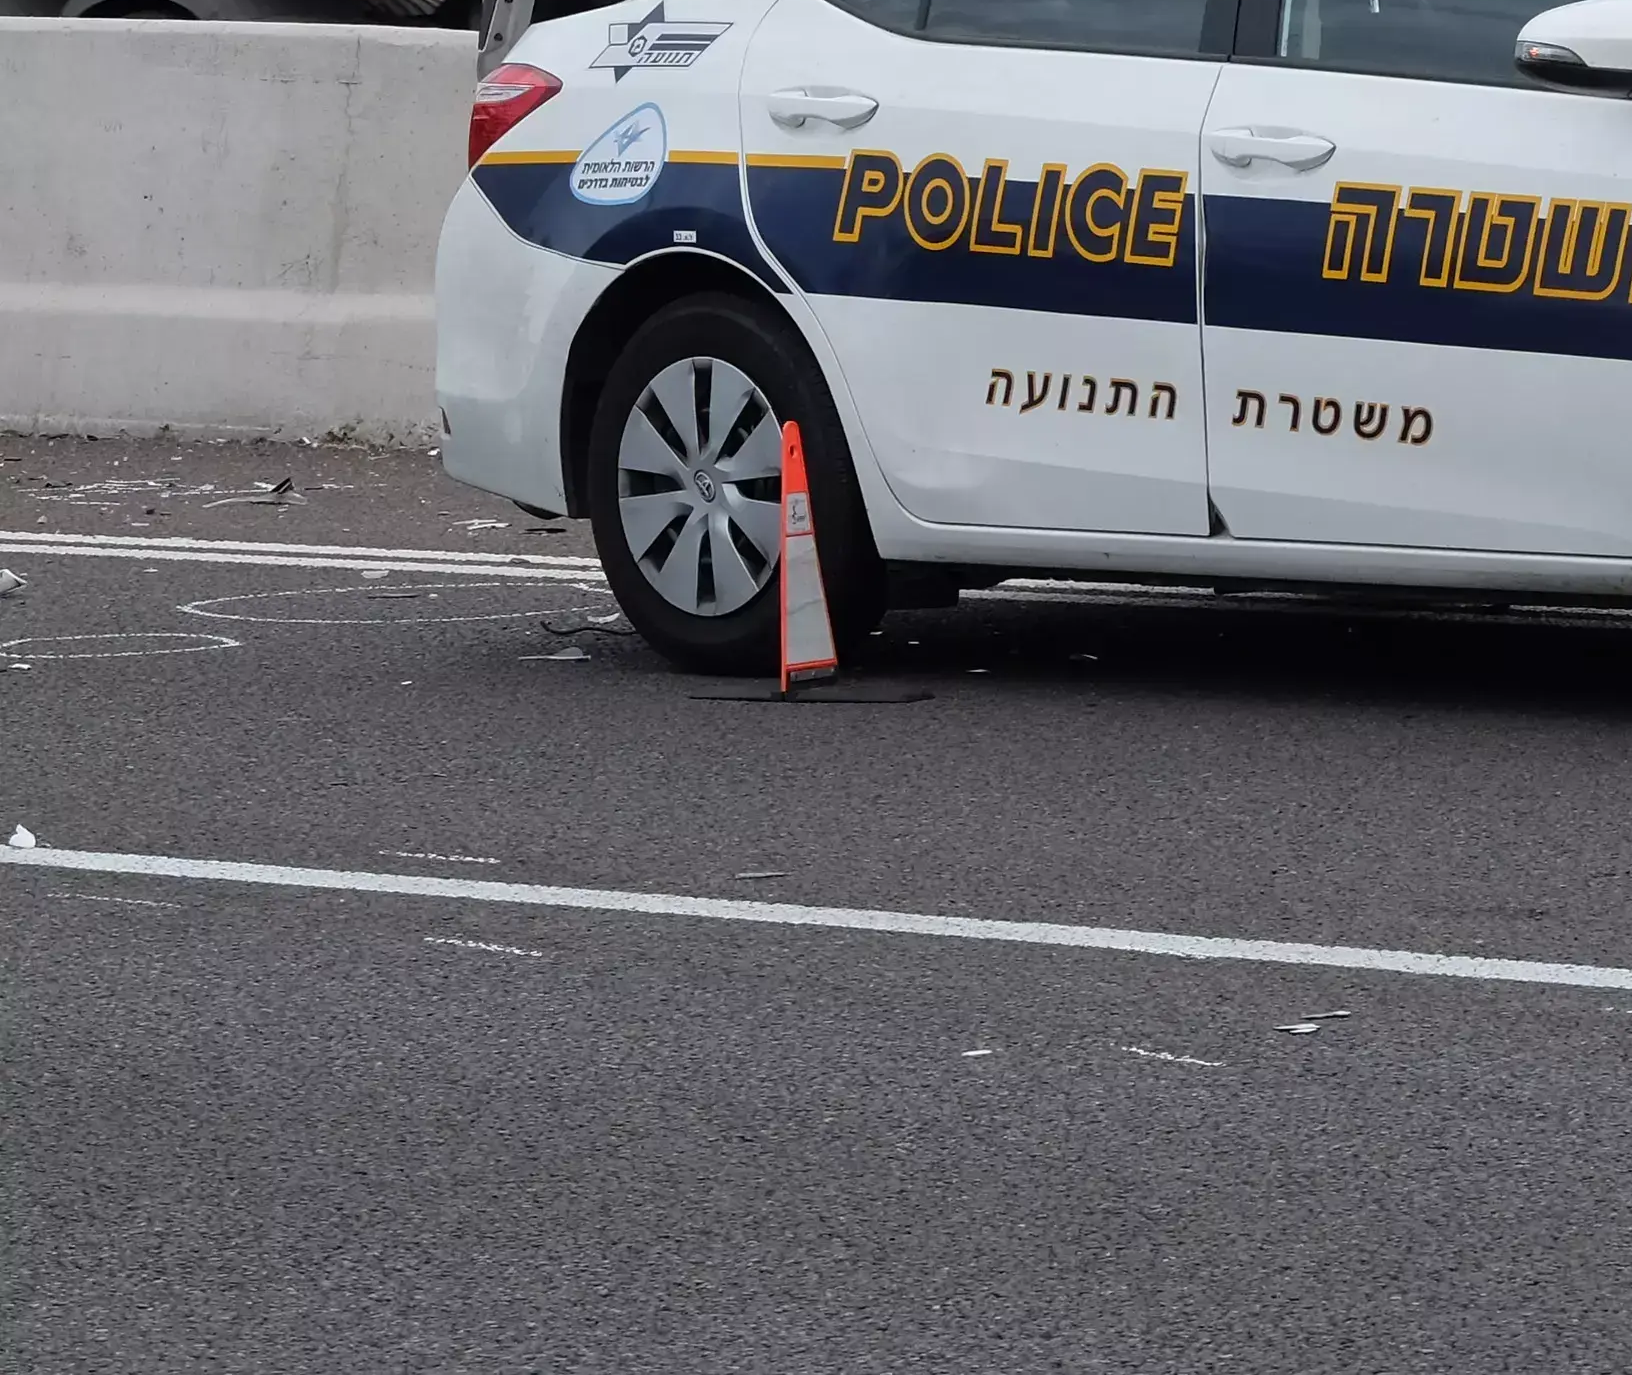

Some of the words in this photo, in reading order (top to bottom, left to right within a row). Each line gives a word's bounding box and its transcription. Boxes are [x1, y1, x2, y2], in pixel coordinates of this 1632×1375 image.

[636, 52, 695, 64] תנועה
[581, 158, 622, 174] הלאומית
[622, 160, 655, 173] הרשות
[577, 177, 608, 190] בדרכים
[609, 174, 650, 188] לבטיחות
[833, 149, 1188, 268] POLICE
[986, 369, 1177, 421] התנועה
[1231, 387, 1434, 446] משטרת
